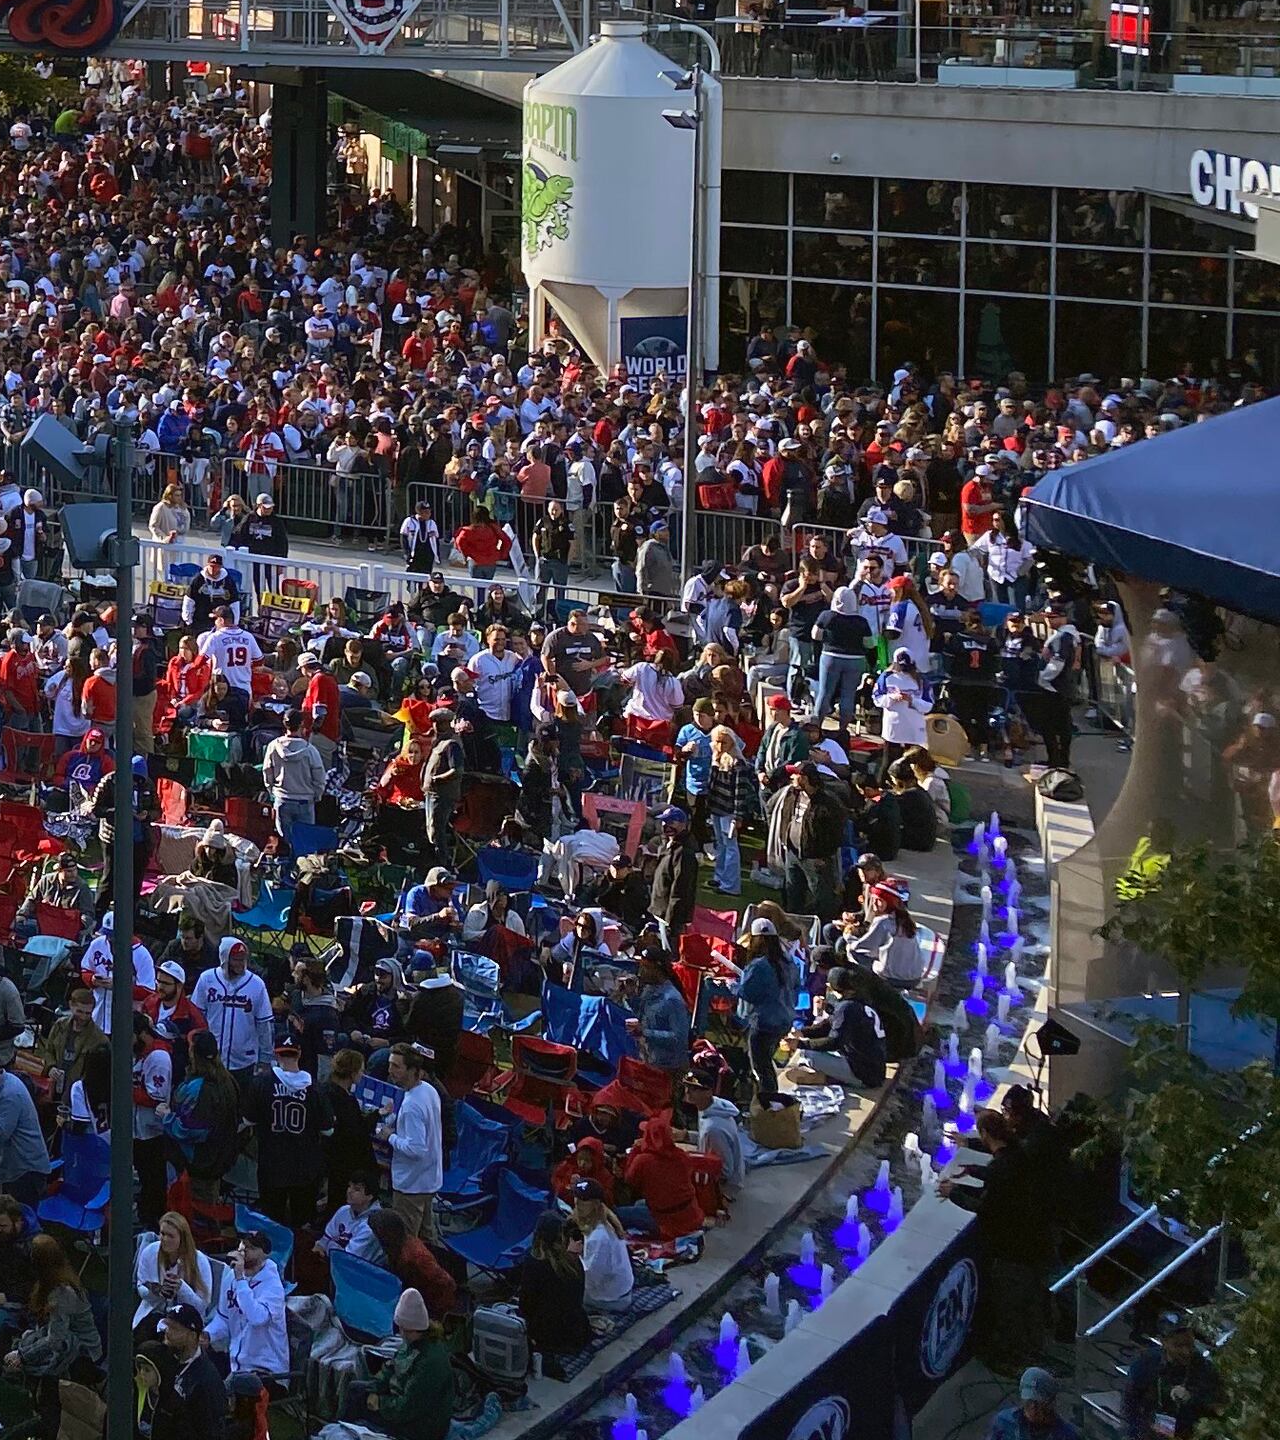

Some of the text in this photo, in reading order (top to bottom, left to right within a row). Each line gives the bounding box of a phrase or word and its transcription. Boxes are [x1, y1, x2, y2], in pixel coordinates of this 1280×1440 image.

[1190, 149, 1280, 219] CHO
[625, 354, 687, 375] WORLD
[270, 596, 304, 609] LSU
[226, 646, 248, 667] 19
[207, 987, 252, 1006] Braves
[864, 1004, 887, 1039] 2
[271, 1101, 307, 1134] 10
